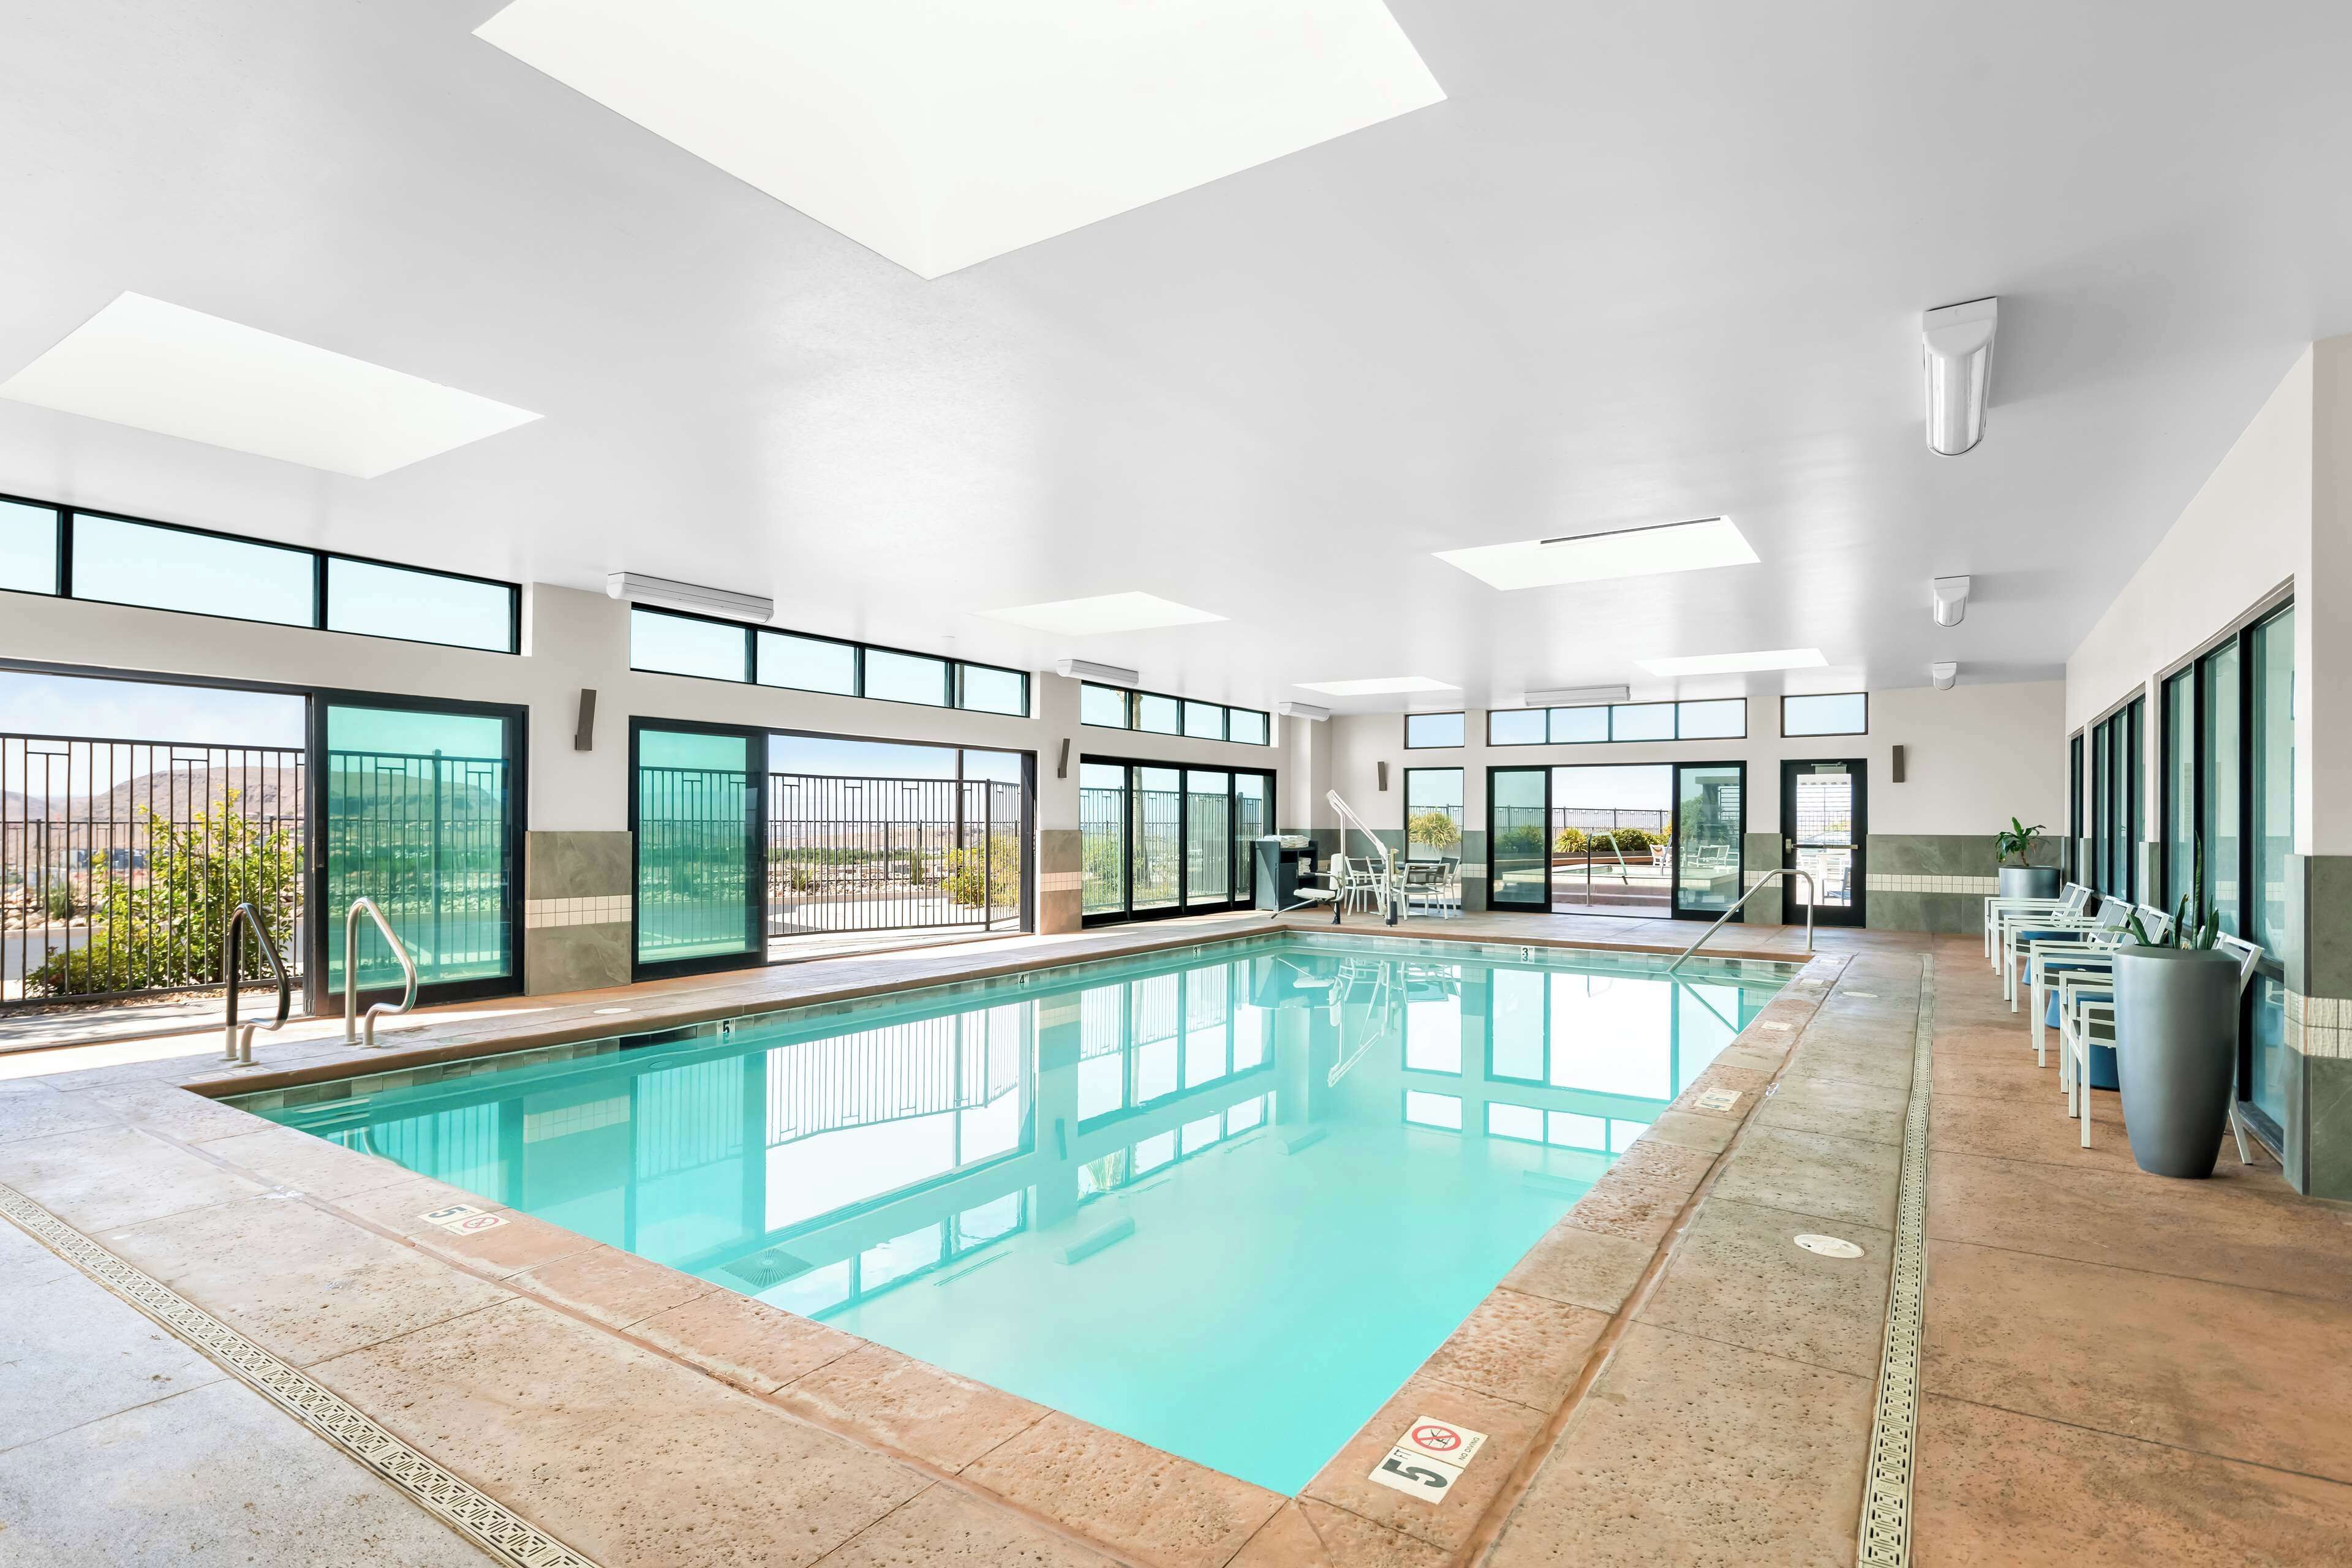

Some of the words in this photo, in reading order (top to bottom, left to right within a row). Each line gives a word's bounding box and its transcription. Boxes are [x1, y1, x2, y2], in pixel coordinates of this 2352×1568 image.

[1019, 974, 1025, 983] 4
[723, 1020, 729, 1033] 5
[428, 1206, 467, 1218] 5
[1393, 1449, 1412, 1460] FT
[1458, 1452, 1468, 1461] NO
[1464, 1437, 1480, 1452] DIVING
[1382, 1458, 1448, 1488] 5
